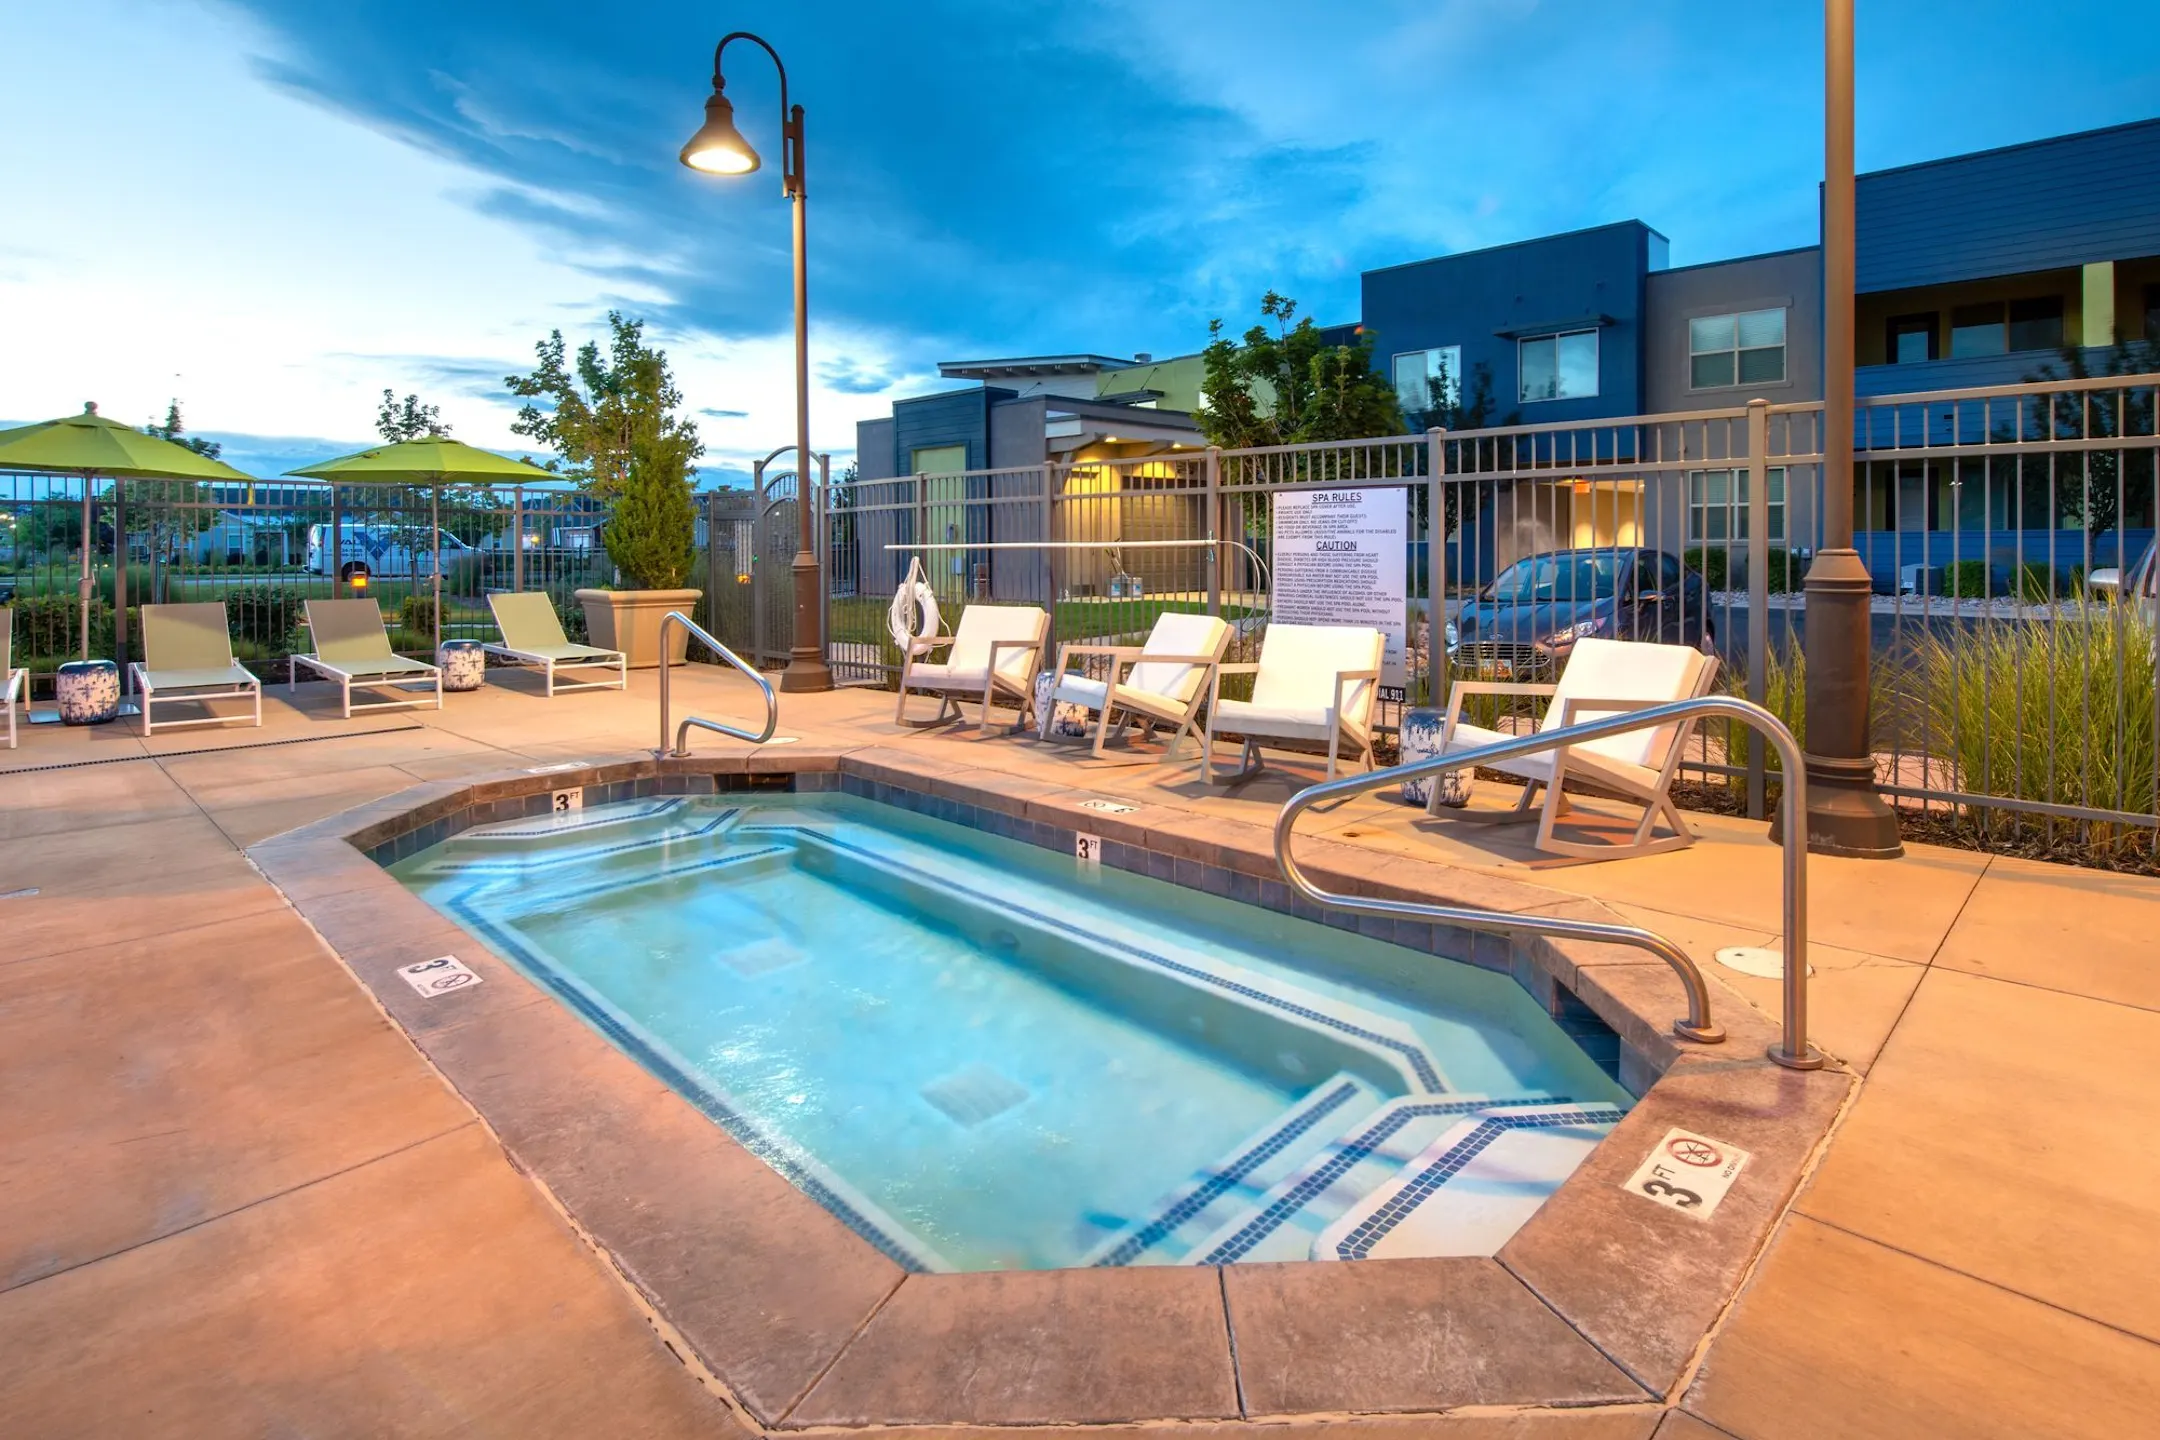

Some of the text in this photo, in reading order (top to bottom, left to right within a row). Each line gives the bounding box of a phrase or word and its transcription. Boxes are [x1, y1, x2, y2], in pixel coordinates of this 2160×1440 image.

[1312, 492, 1362, 502] SPA RULES
[1316, 541, 1357, 551] CAUTION
[1391, 689, 1404, 701] 911
[556, 791, 580, 812] 3 FT
[1078, 838, 1098, 859] 3 FT
[408, 959, 449, 974] 3
[1722, 1170, 1732, 1179] NO
[1642, 1163, 1703, 1209] 3 FT
